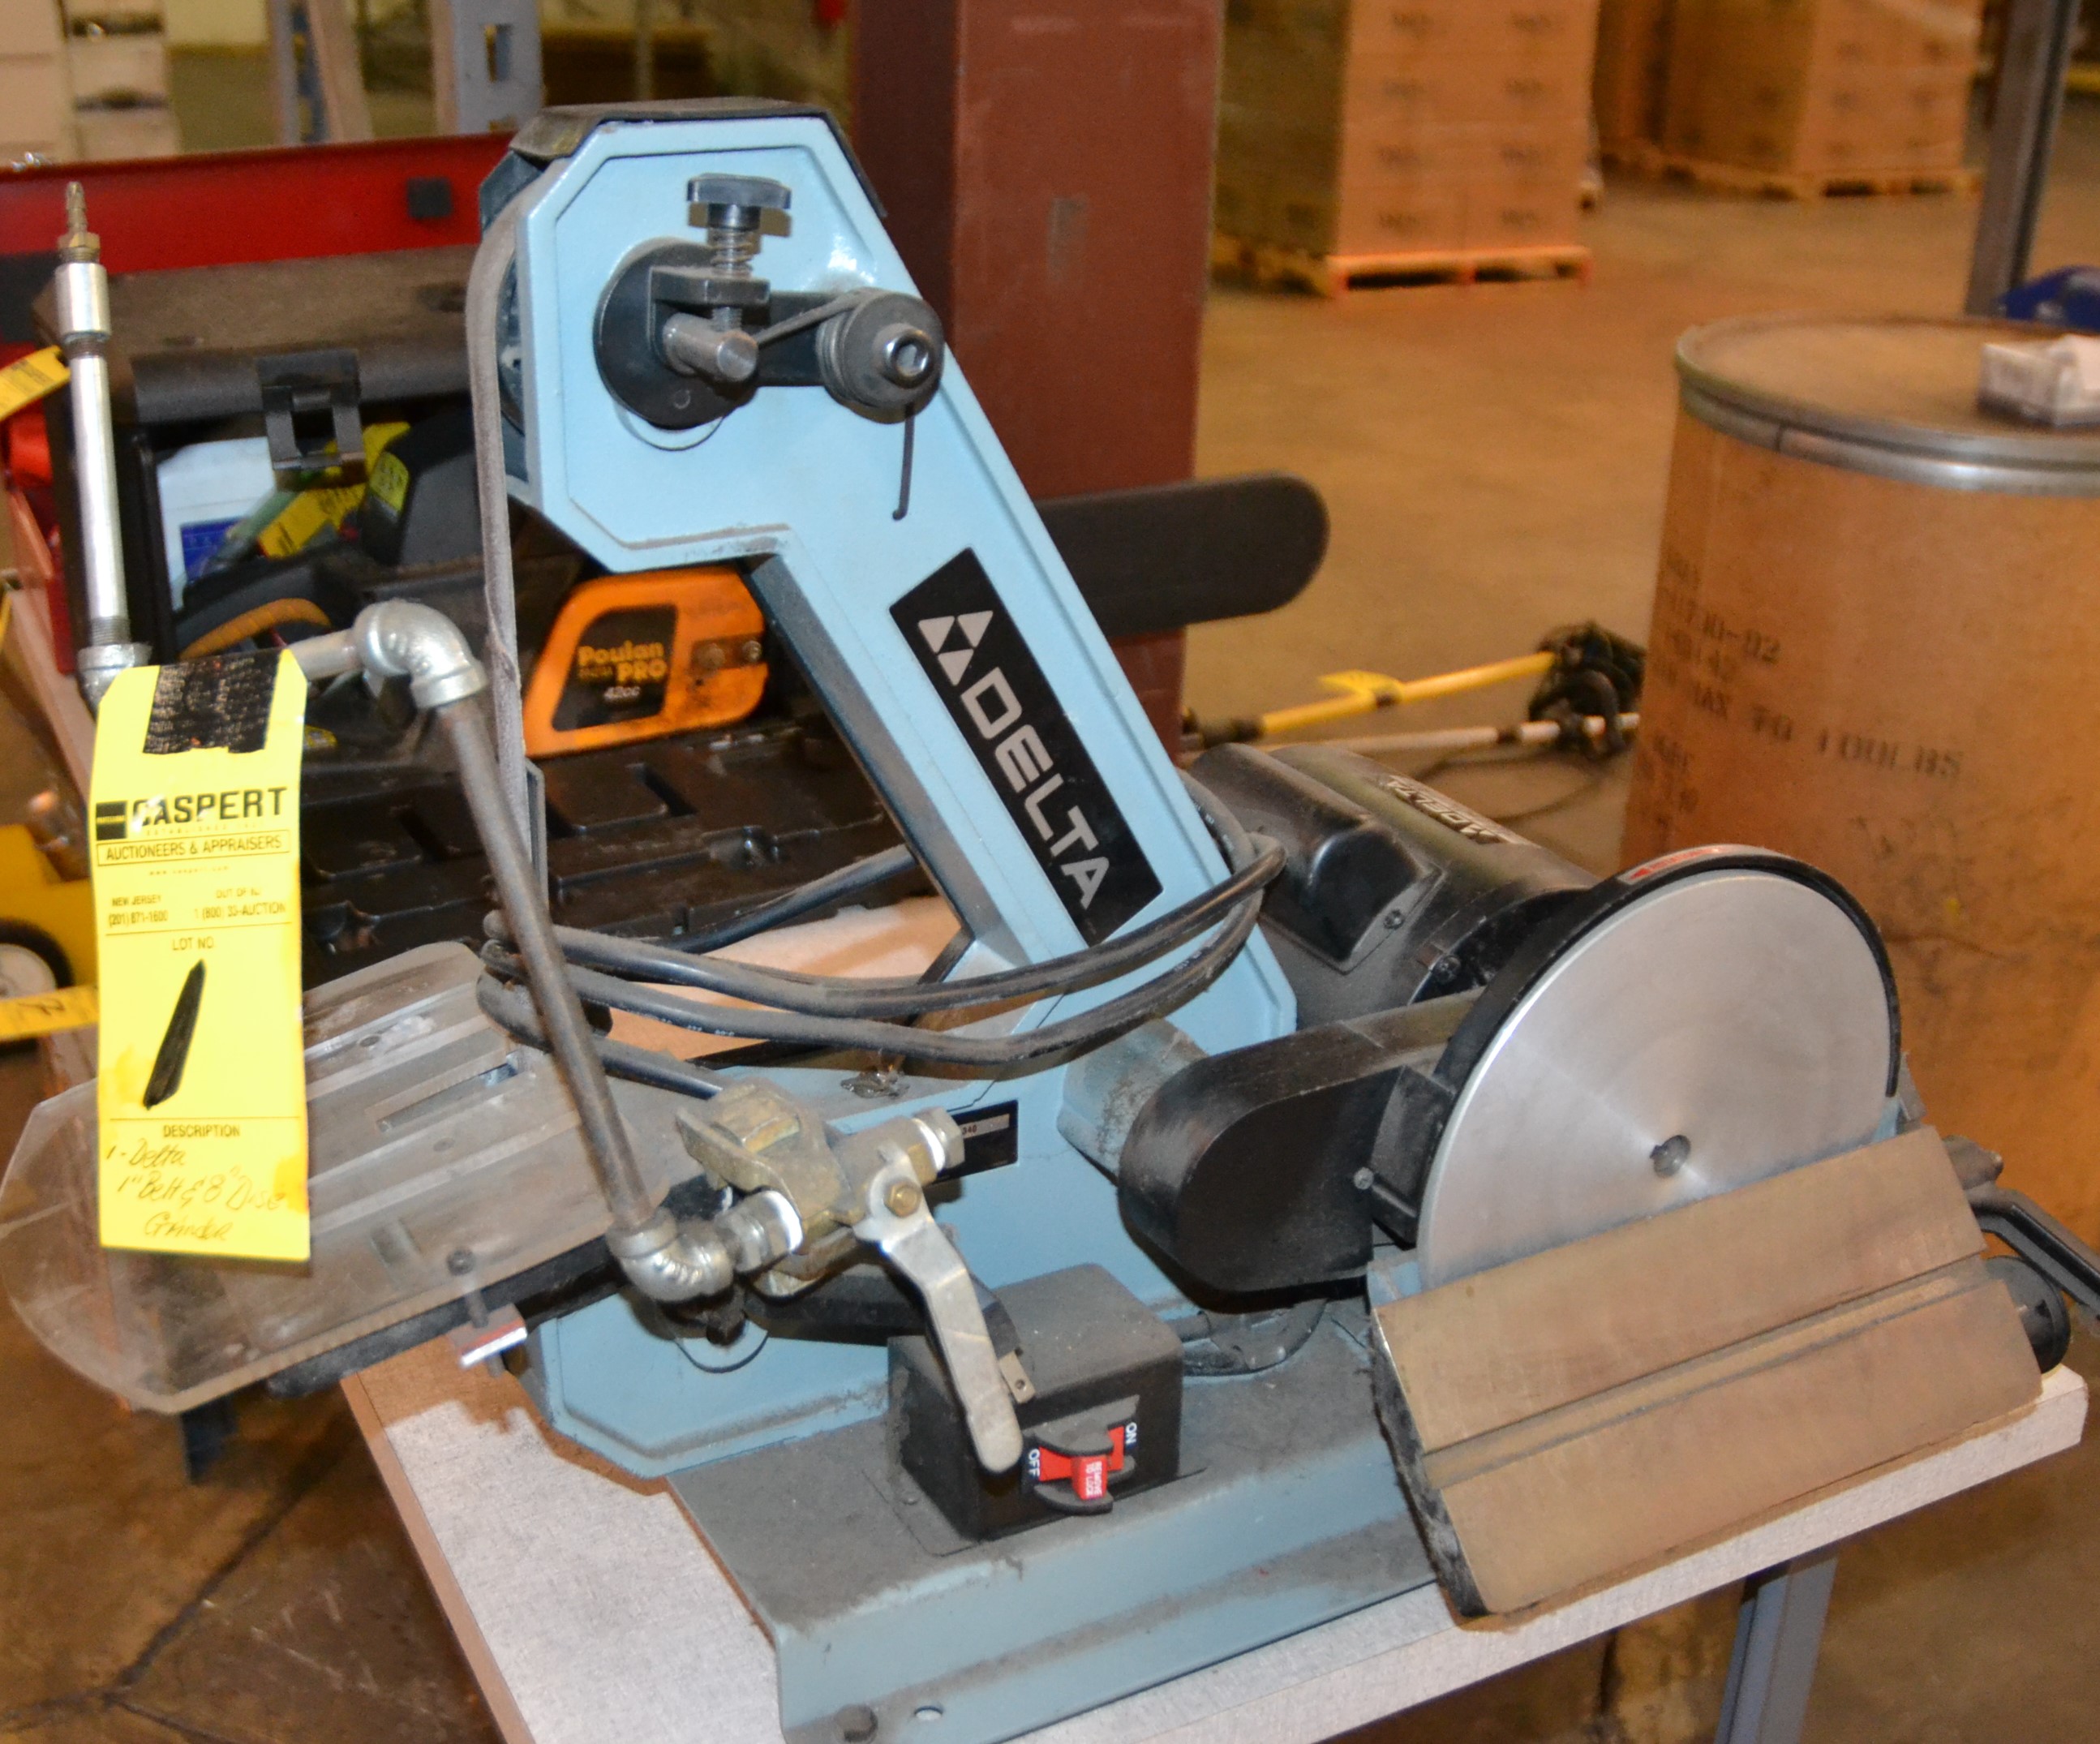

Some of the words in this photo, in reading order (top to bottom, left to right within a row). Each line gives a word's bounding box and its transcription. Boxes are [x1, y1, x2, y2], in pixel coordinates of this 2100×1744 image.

[577, 640, 664, 667] Poulan
[616, 659, 668, 683] PRO
[960, 667, 1110, 910] DELTA
[106, 843, 185, 861] AUCTIONEERS
[190, 842, 198, 854] &
[203, 835, 282, 853] APPRAISERS
[112, 896, 130, 907] NEW
[131, 894, 161, 905] JERSEY
[216, 887, 232, 899] OUT
[172, 937, 193, 951] LOT
[163, 1124, 240, 1137] DESCRIPTION
[1125, 1421, 1138, 1445] ON
[1029, 1448, 1041, 1478] OFF
